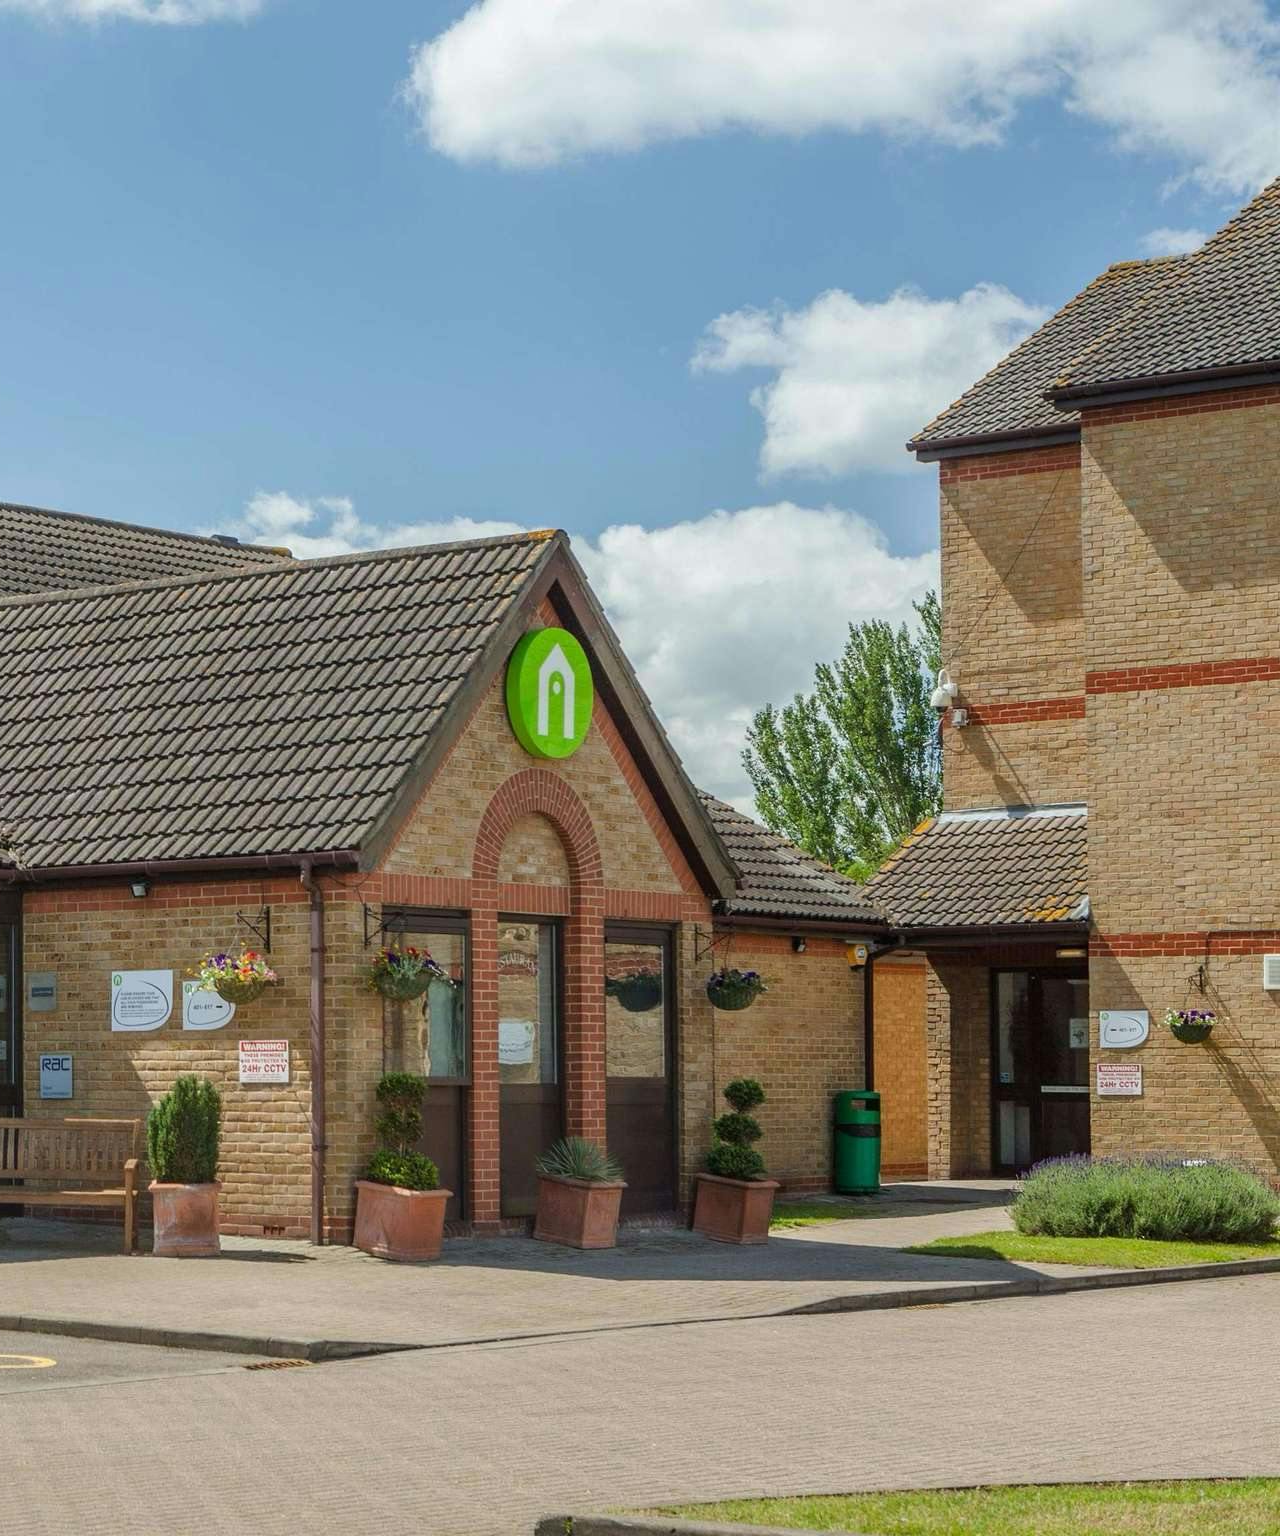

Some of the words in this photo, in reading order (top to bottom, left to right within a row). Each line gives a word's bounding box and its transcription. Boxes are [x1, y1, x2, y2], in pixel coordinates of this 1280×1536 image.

[242, 1043, 286, 1051] WARNING!
[242, 1064, 262, 1072] 24Hr
[263, 1063, 287, 1073] CCTV
